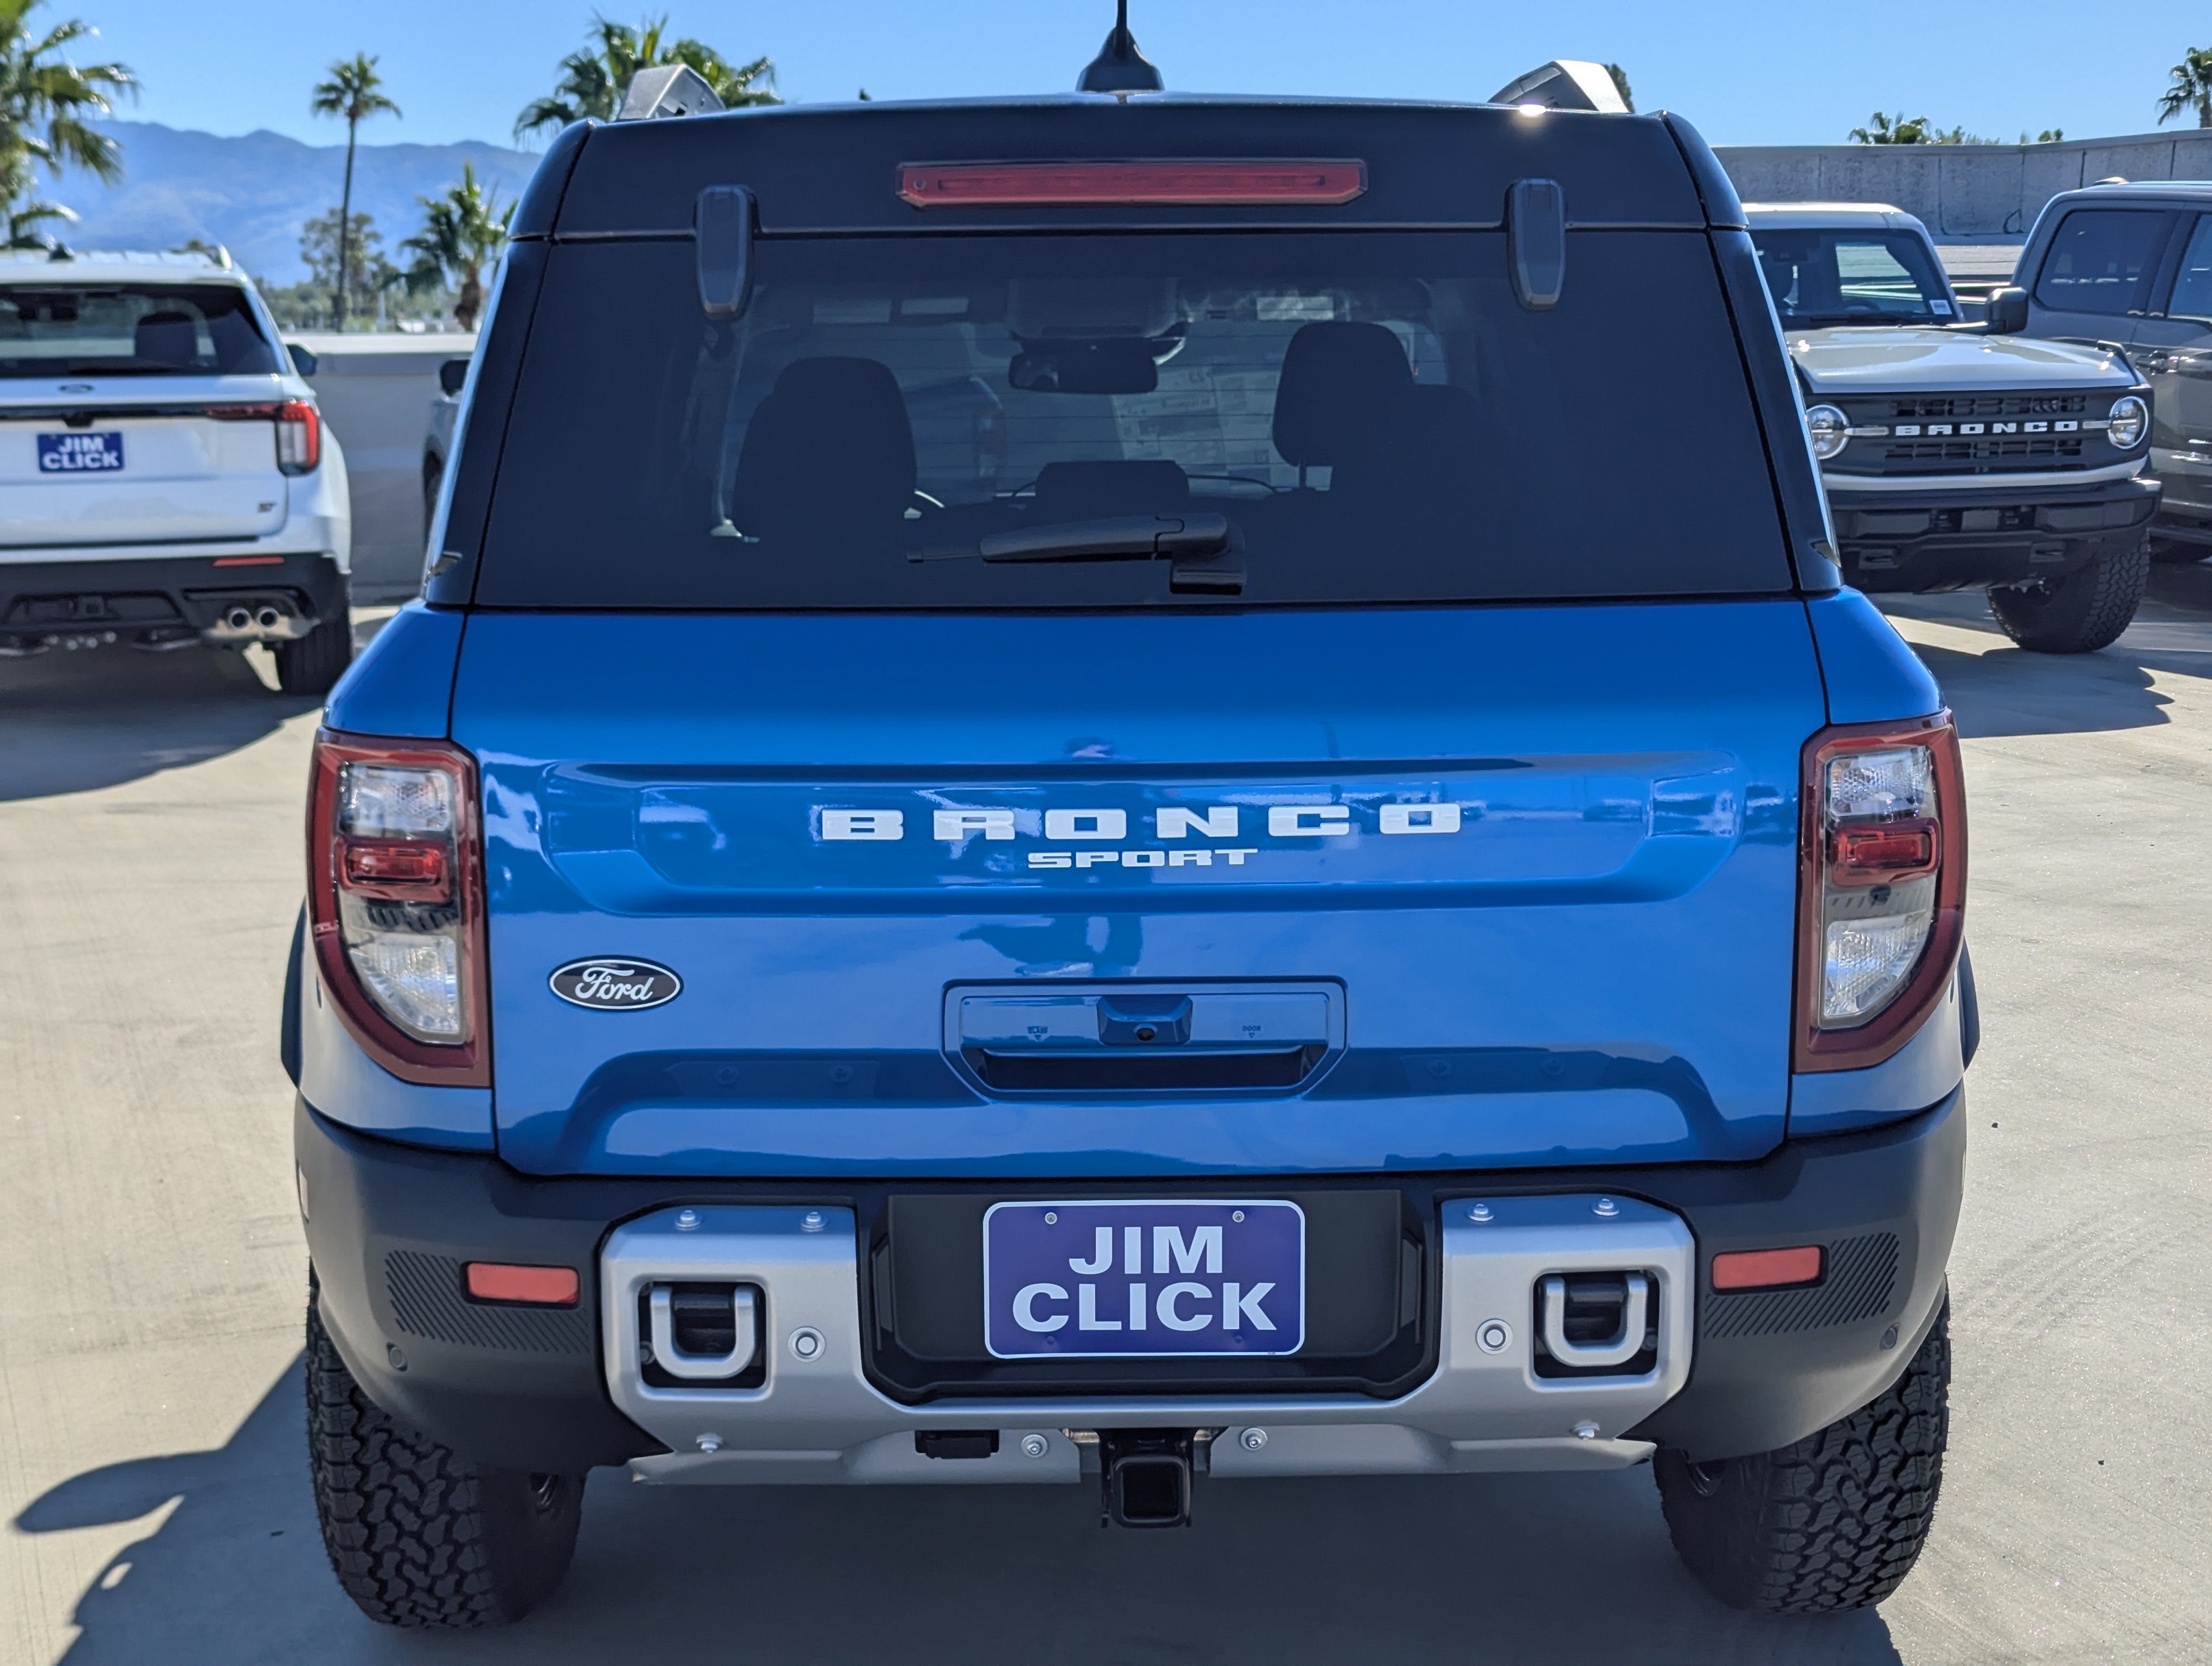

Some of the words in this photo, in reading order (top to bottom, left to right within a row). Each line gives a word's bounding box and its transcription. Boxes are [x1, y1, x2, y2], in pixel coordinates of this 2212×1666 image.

[1895, 421, 2078, 435] BRONCO
[57, 436, 104, 452] JIM
[43, 450, 119, 469] CLICK
[822, 803, 1461, 841] BRONCO
[1027, 848, 1258, 868] SPORT
[575, 967, 654, 1000] Ford
[1069, 1226, 1223, 1274] JIM
[1012, 1281, 1277, 1332] CLICK
